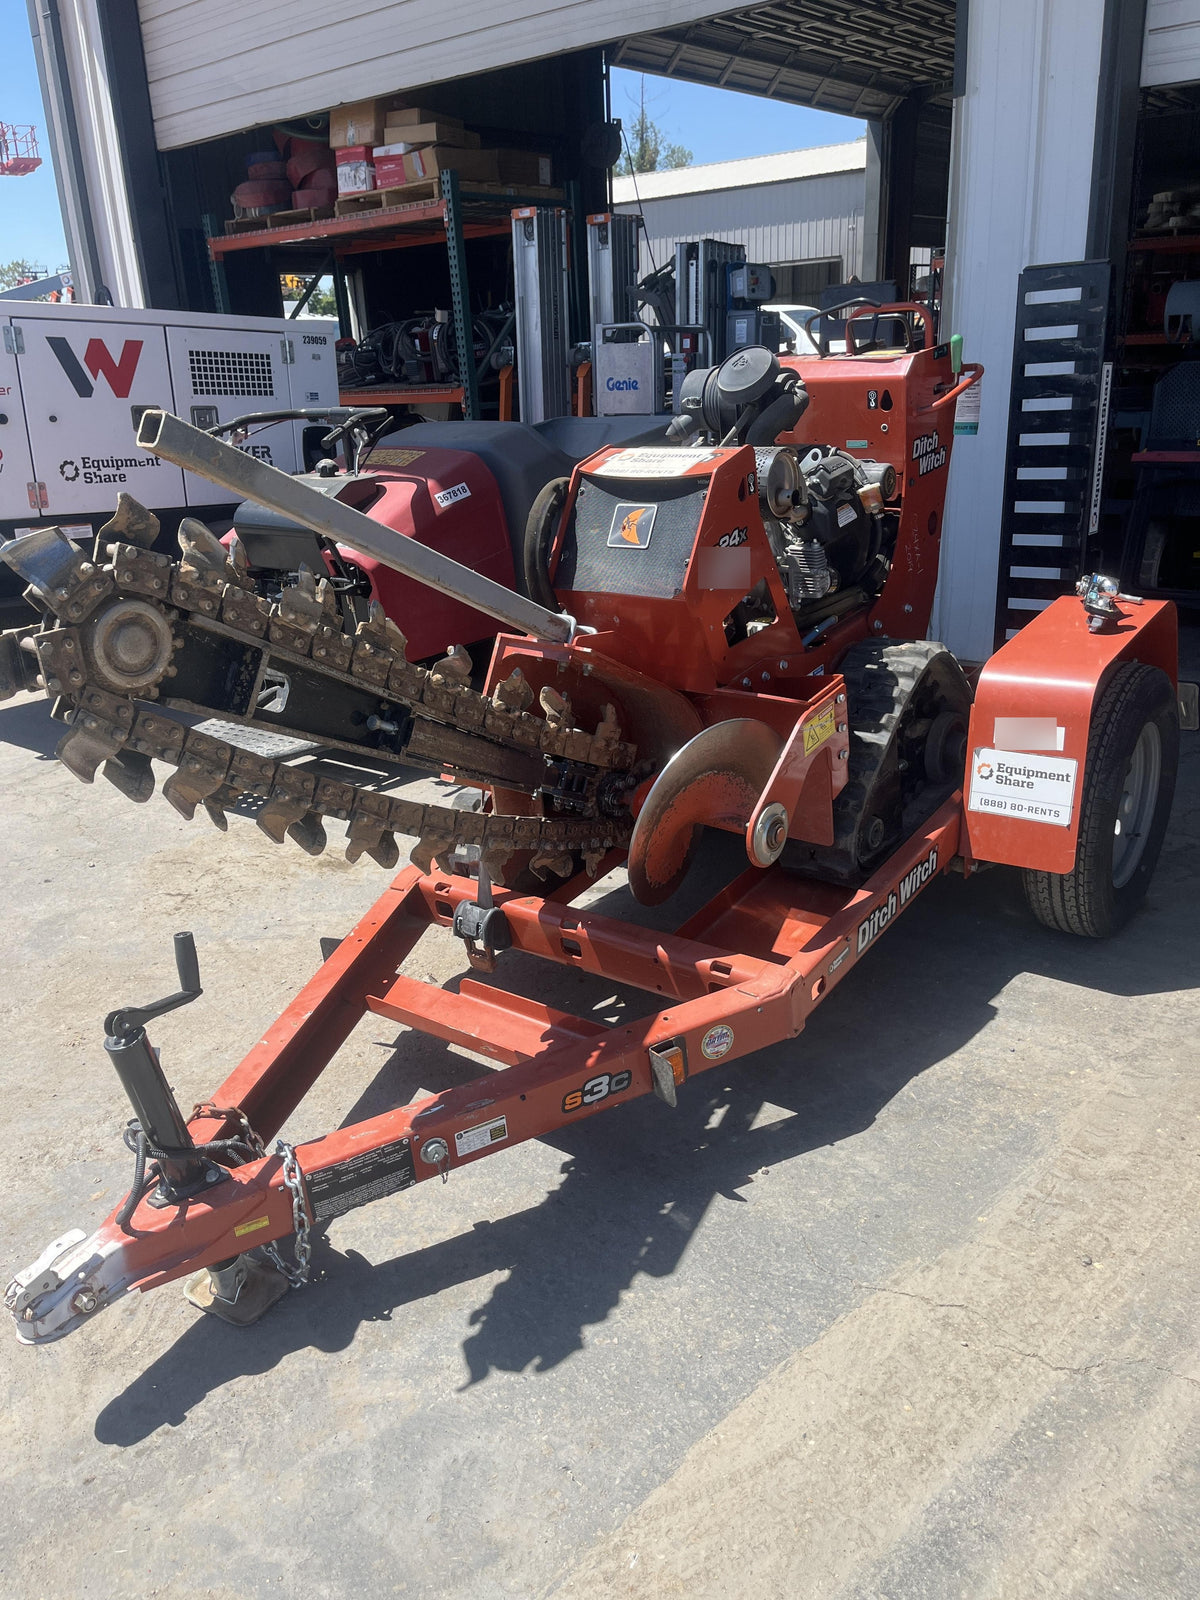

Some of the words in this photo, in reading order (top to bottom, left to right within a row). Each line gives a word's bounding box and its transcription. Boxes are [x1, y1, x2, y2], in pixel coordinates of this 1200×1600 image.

[302, 335, 327, 346] 239059
[606, 376, 639, 391] Genie
[913, 431, 939, 459] Ditch
[919, 448, 946, 476] Witch
[83, 471, 127, 484] Share
[437, 485, 468, 504] 367818
[995, 774, 1035, 789] Share
[996, 762, 1071, 783] Equipment
[979, 797, 1007, 810] (888)
[1010, 802, 1061, 818] 80-RENTS
[857, 892, 897, 953] Ditch
[899, 849, 938, 905] Witch
